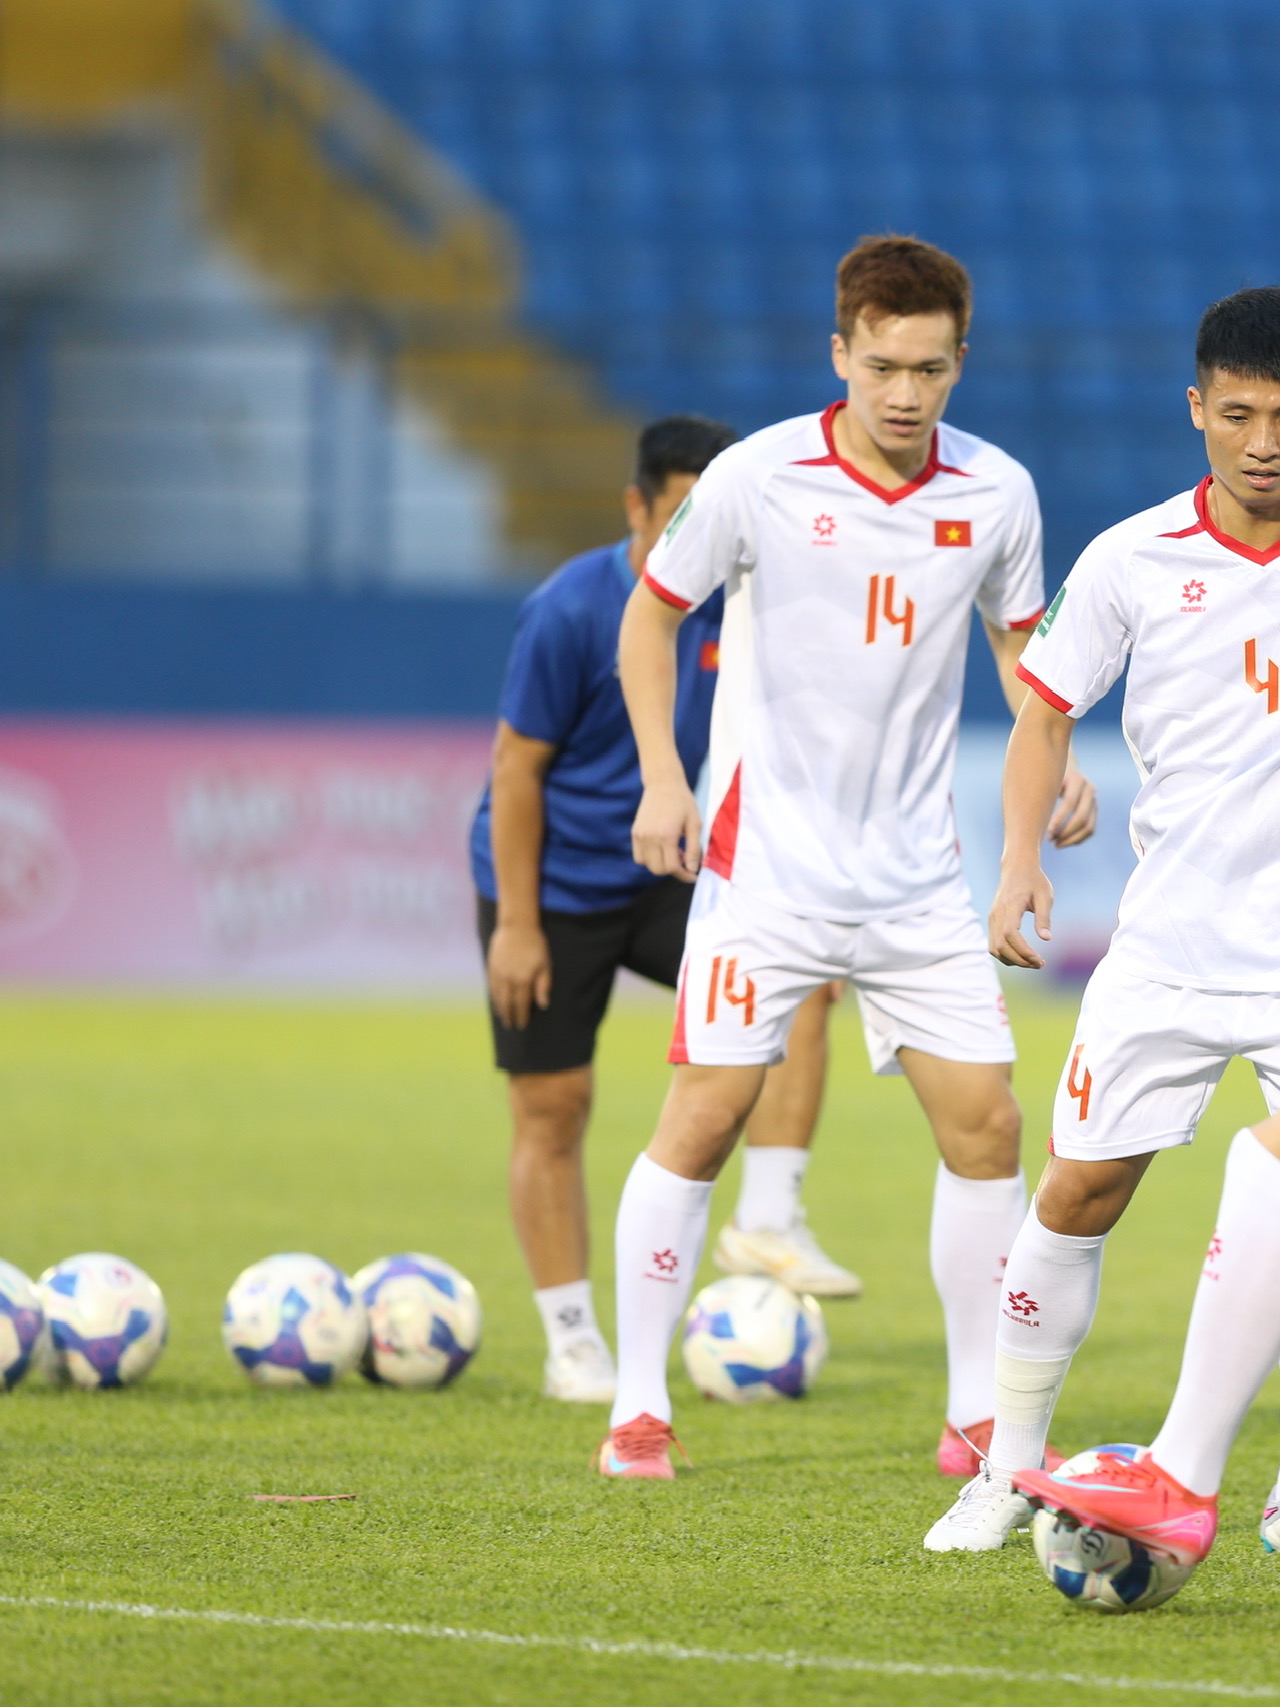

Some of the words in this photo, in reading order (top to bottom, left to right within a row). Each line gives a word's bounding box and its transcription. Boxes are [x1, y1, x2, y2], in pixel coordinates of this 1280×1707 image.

[865, 573, 915, 647] 14
[1244, 637, 1280, 715] 4
[705, 955, 756, 1027] 14
[1066, 1043, 1092, 1122] 4
